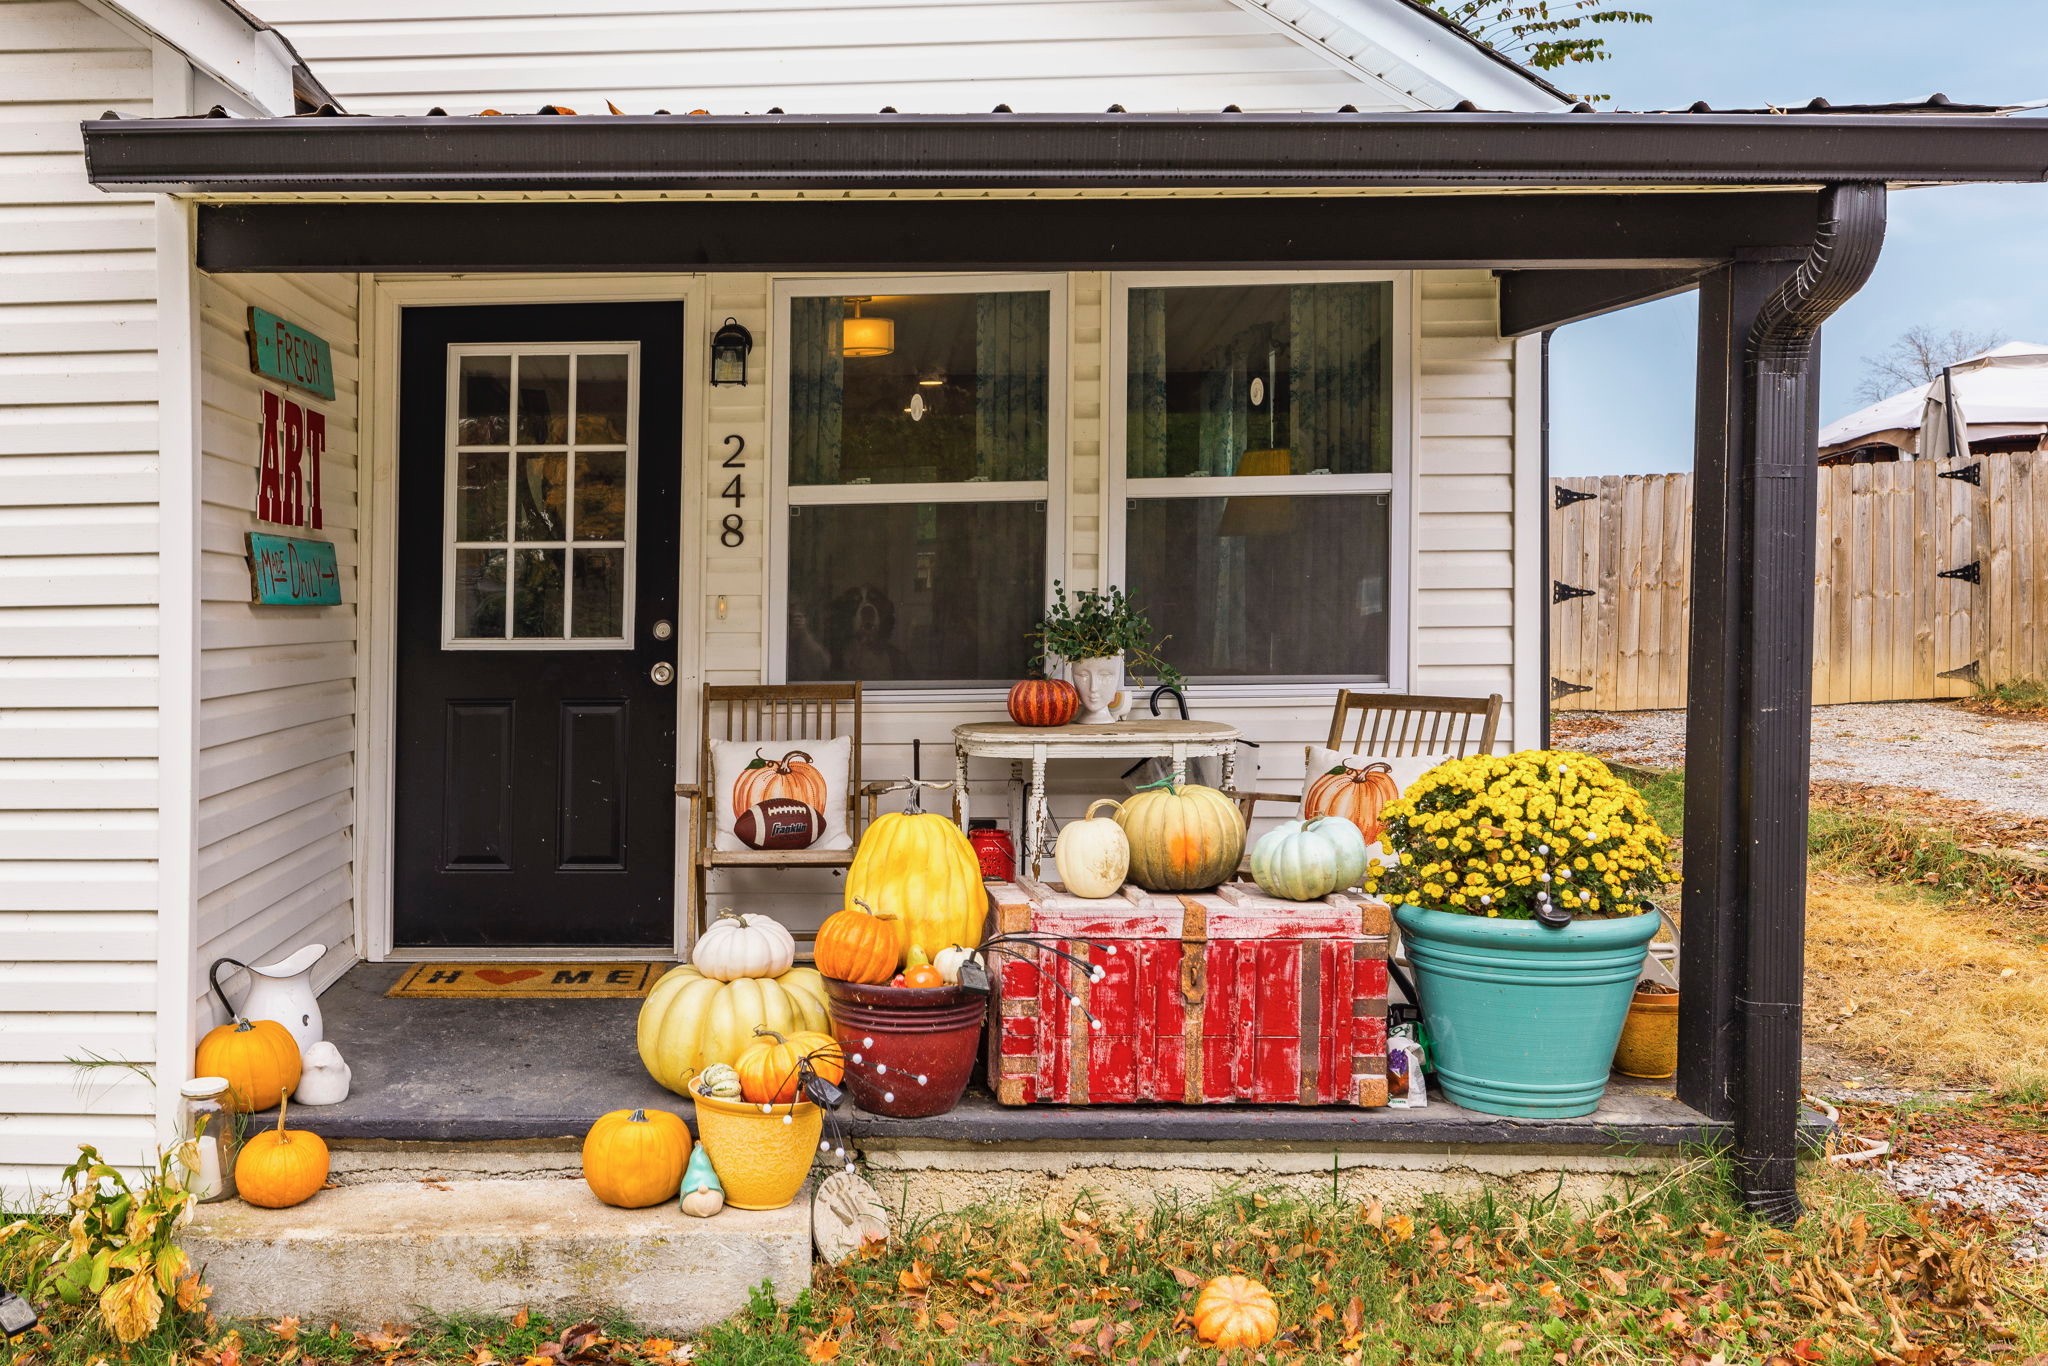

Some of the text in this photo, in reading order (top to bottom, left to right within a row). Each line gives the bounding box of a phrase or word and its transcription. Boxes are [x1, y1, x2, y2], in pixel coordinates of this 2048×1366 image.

[276, 322, 320, 385] FRESH
[256, 389, 326, 530] ART
[721, 434, 746, 548] 248
[261, 543, 322, 598] MADE DAILY
[771, 822, 807, 837] Franklin
